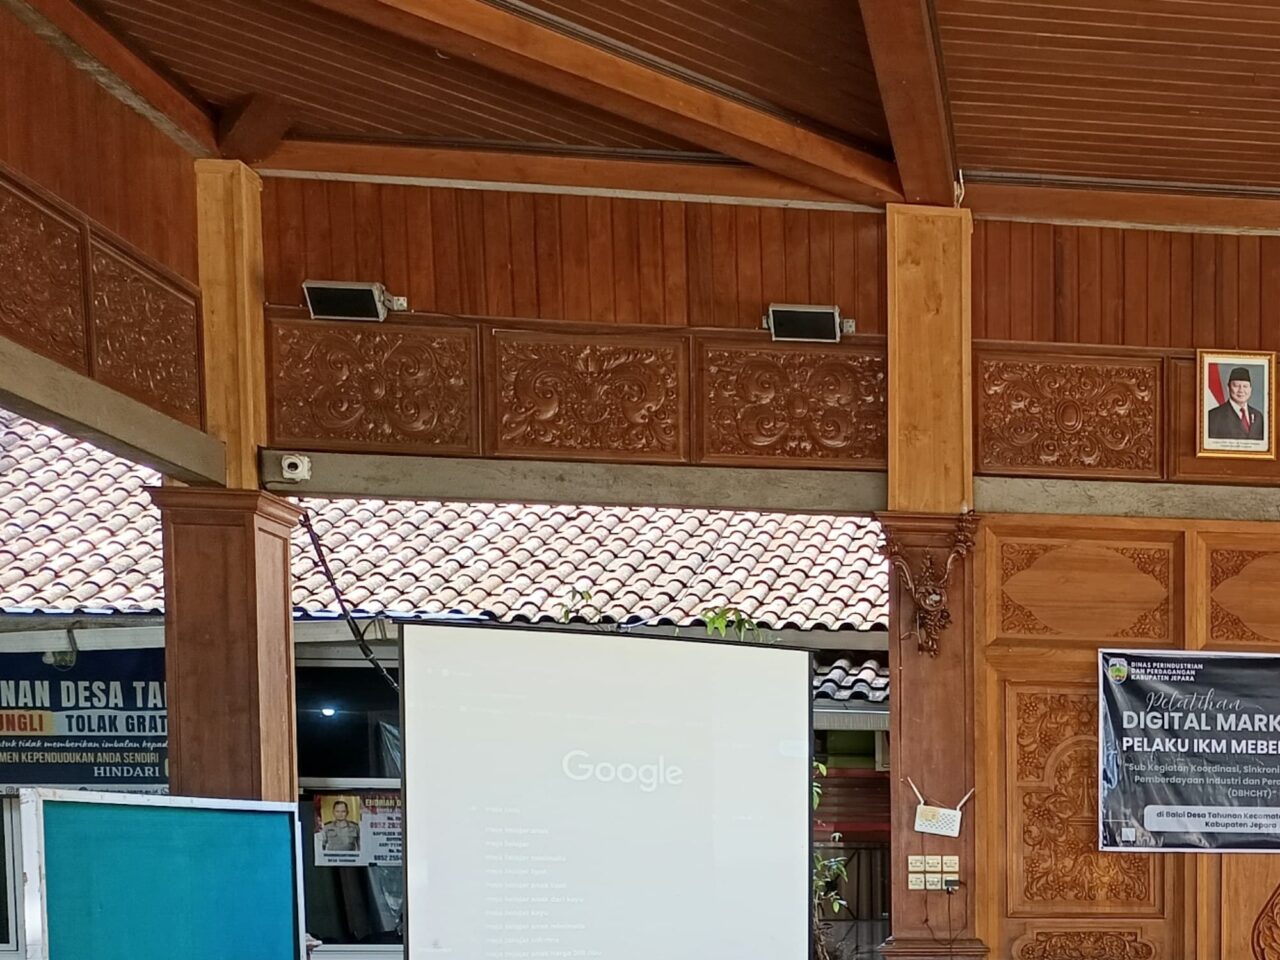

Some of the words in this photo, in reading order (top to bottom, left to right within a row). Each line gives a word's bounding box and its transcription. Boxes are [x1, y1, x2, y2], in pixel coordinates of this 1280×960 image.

[1153, 662, 1203, 670] PERINDUSTRIAN
[60, 680, 124, 708] DESA
[132, 681, 167, 708] TA
[1146, 687, 1255, 712] Pelatihan
[65, 714, 118, 733] TOLAK
[1122, 710, 1211, 731] DIGITAL
[1122, 736, 1189, 753] PELAKU
[1193, 738, 1227, 754] IKM
[21, 751, 94, 764] KEPENDUDUKAN
[96, 752, 121, 764] ANDA
[123, 752, 159, 764] SENDIRI
[93, 766, 160, 777] HINDARI
[561, 748, 684, 793] Google
[1148, 763, 1188, 773] Kegiatan
[1134, 775, 1205, 786] Pemberdayaan
[1206, 776, 1241, 785] Industri
[1243, 777, 1260, 786] dan
[1205, 820, 1247, 829] Kabupaten
[1249, 821, 1277, 829] Jepara
